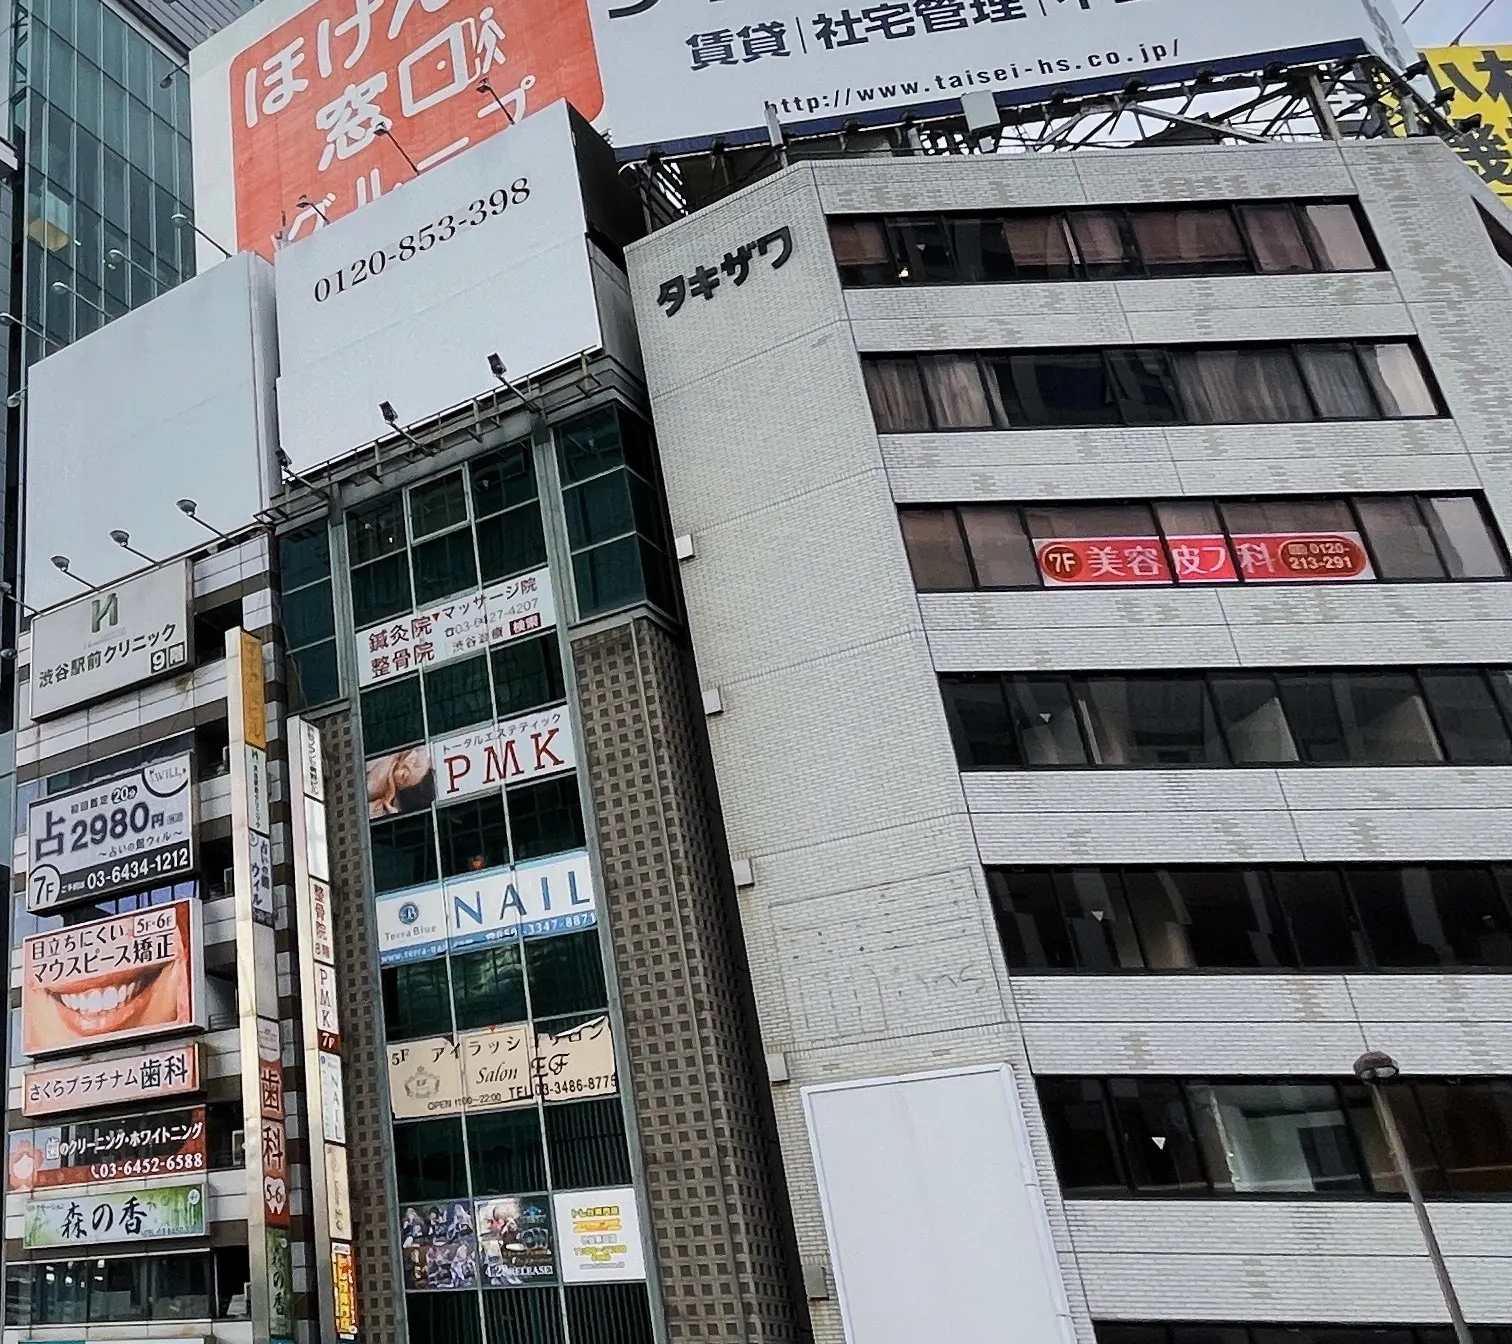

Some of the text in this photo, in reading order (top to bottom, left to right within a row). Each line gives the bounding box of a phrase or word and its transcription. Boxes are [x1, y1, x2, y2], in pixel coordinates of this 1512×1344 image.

[685, 18, 791, 70] 賃貸
[315, 14, 482, 174] 窓口
[763, 37, 1181, 115] http://www.taisei-hs.co.jp/
[313, 176, 532, 304] 0120-853-398
[656, 223, 793, 318] タキザワ
[1048, 552, 1076, 573] 7F
[1087, 542, 1276, 577] 美容皮フ科
[1289, 555, 1354, 570] 213-291
[441, 577, 538, 619] マッサージ院
[455, 598, 539, 636] 03-627-4207
[38, 623, 176, 688] 渋谷駅前クリニック
[369, 615, 433, 653] 鍼灸院
[371, 642, 435, 679] 整骨院
[442, 712, 562, 755] トータルエステティック
[443, 728, 565, 795] PMK
[35, 810, 67, 863] 占
[70, 801, 165, 854] 2980円
[34, 875, 55, 905] 7F
[87, 847, 189, 890] 03-6434-1212
[454, 871, 591, 929] NAIL
[32, 924, 124, 961] 目立ちにくい
[32, 932, 176, 983] マウスピース矯正
[30, 1053, 188, 1102] さくらプラチナム歯科
[391, 1048, 410, 1066] 5F
[475, 1061, 519, 1085] Salon
[46, 1121, 203, 1160] 歯のクリーニング・ホワイトニング
[261, 1068, 283, 1170] 歯科
[99, 1152, 203, 1179] 03-6452-6588
[62, 1196, 147, 1239] 森の香
